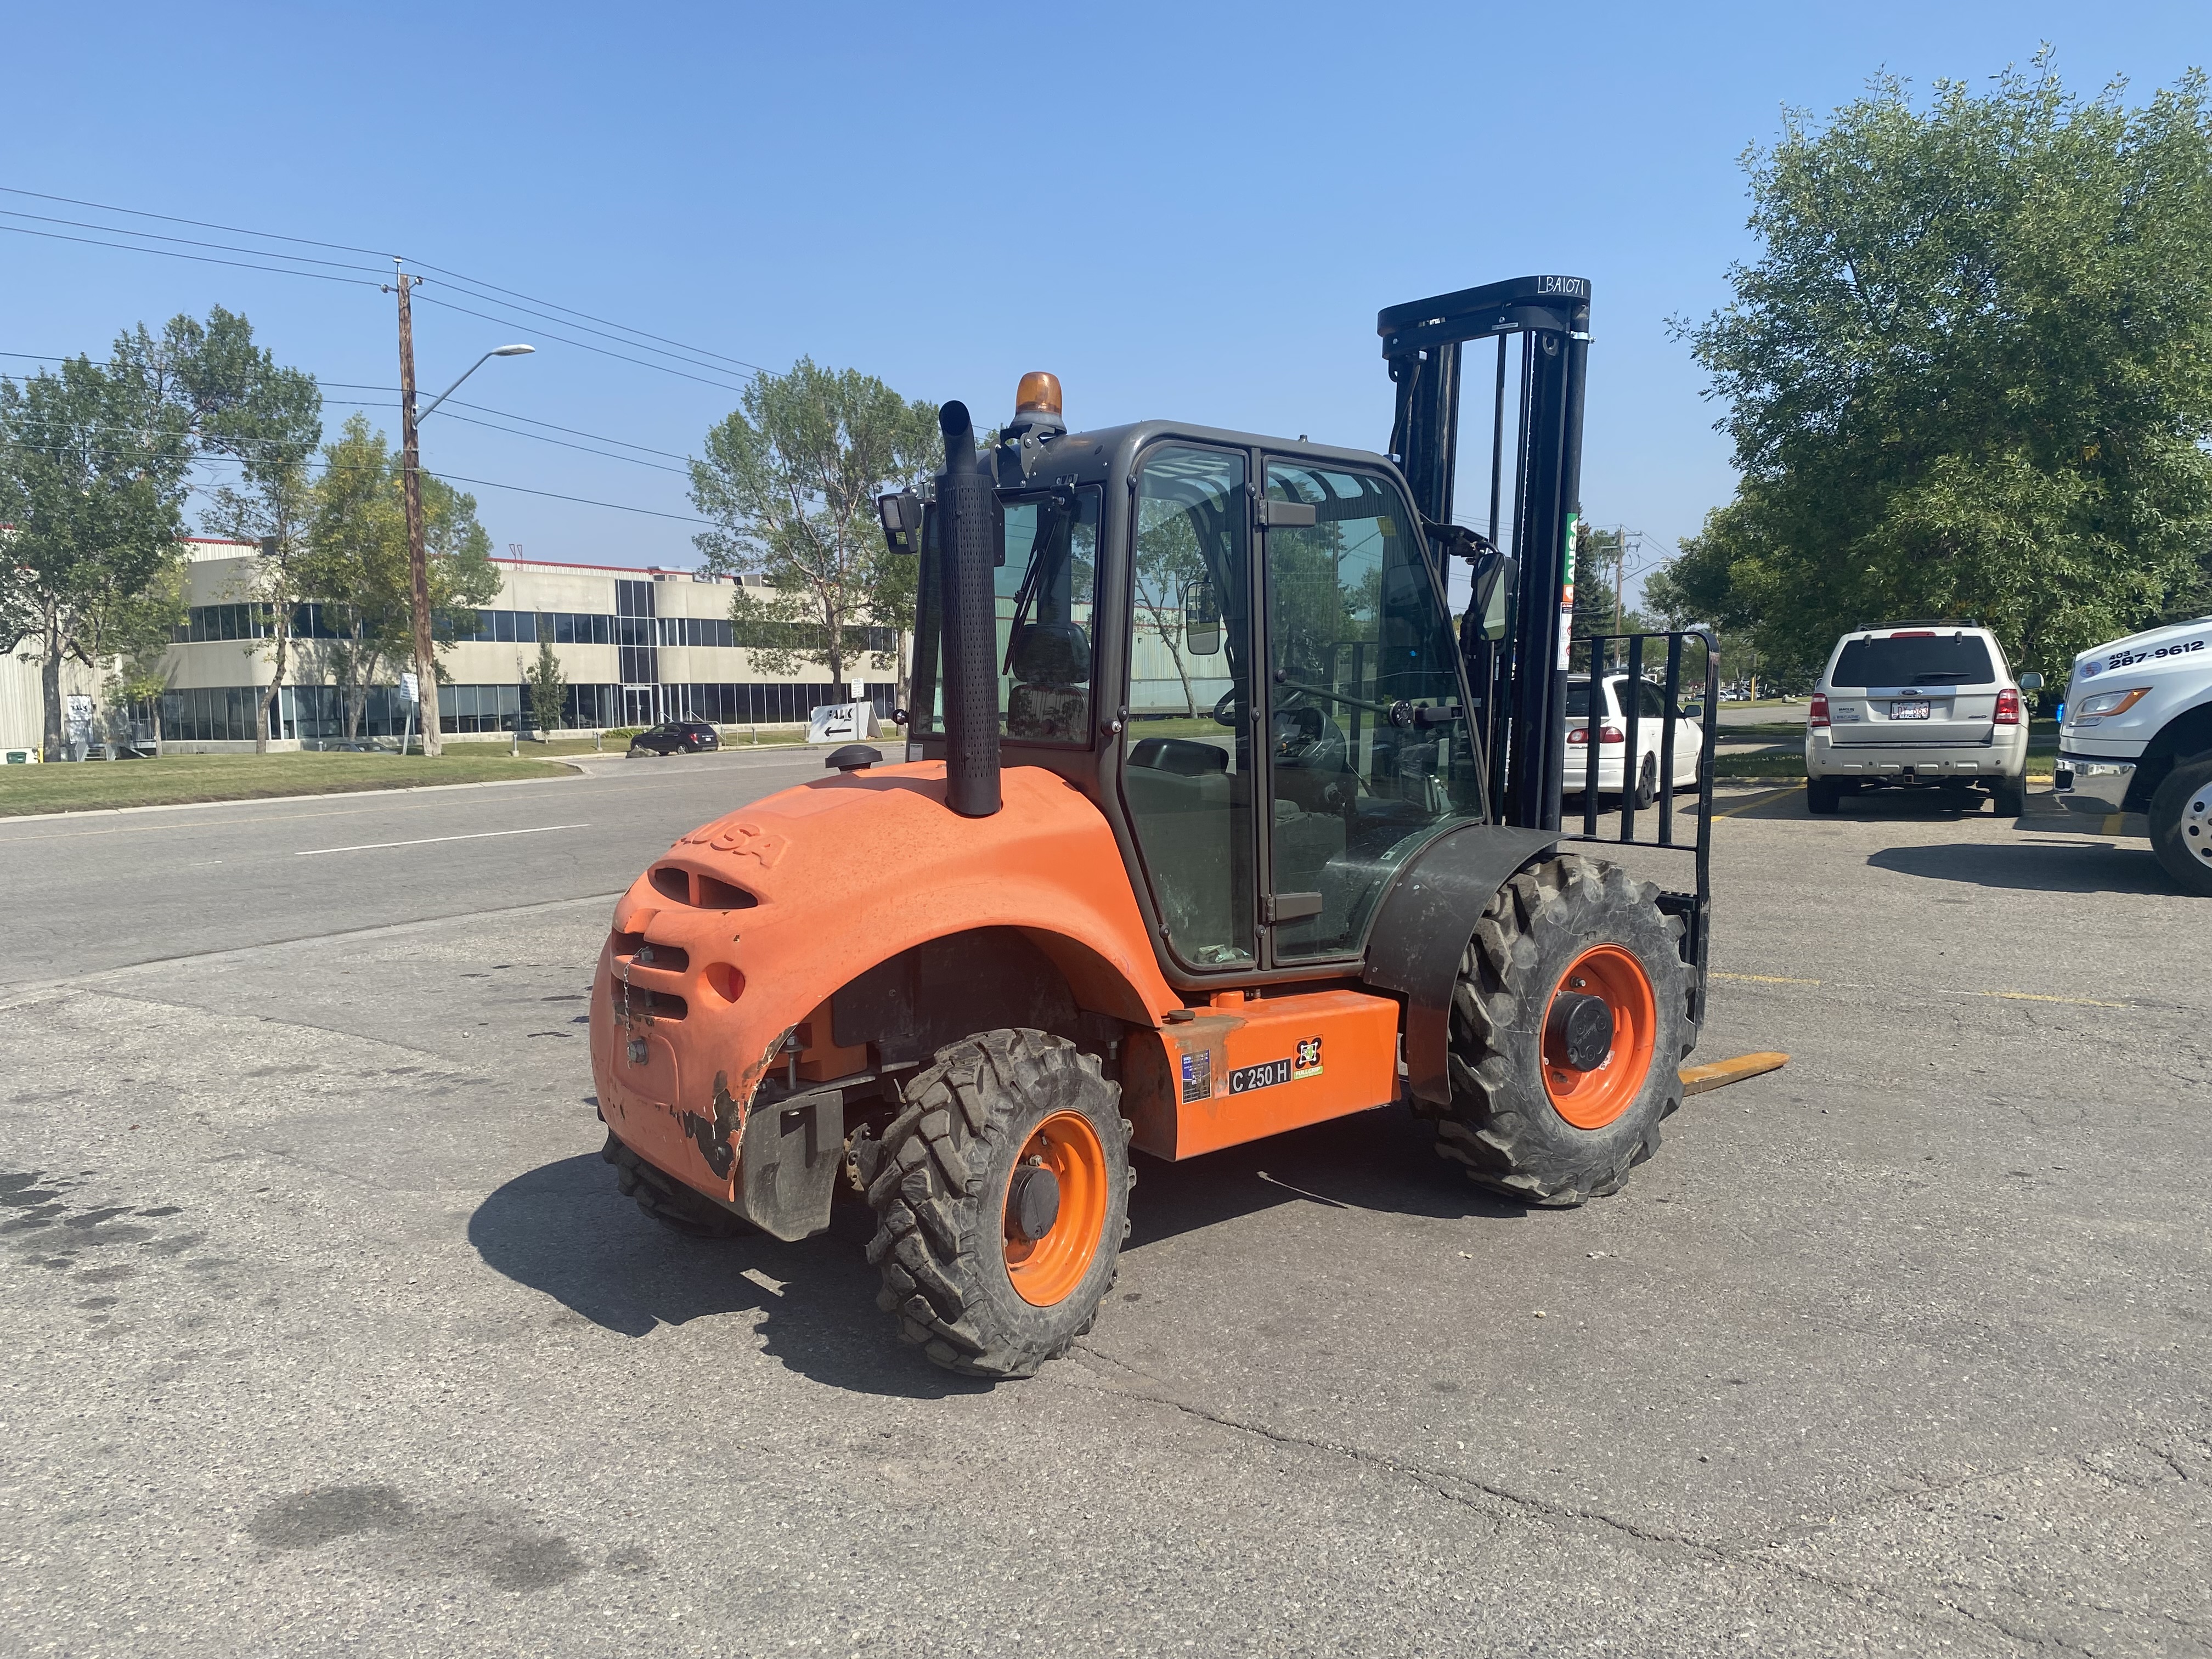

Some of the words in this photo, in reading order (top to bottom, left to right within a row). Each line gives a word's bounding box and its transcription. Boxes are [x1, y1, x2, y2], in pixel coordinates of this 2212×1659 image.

[1537, 276, 1584, 296] LBA1071
[2108, 640, 2205, 670] 287-9612
[2109, 651, 2131, 660] 403
[671, 822, 790, 870] USA
[1233, 1071, 1243, 1092] C
[1248, 1065, 1273, 1089] 250
[1277, 1062, 1287, 1082] H
